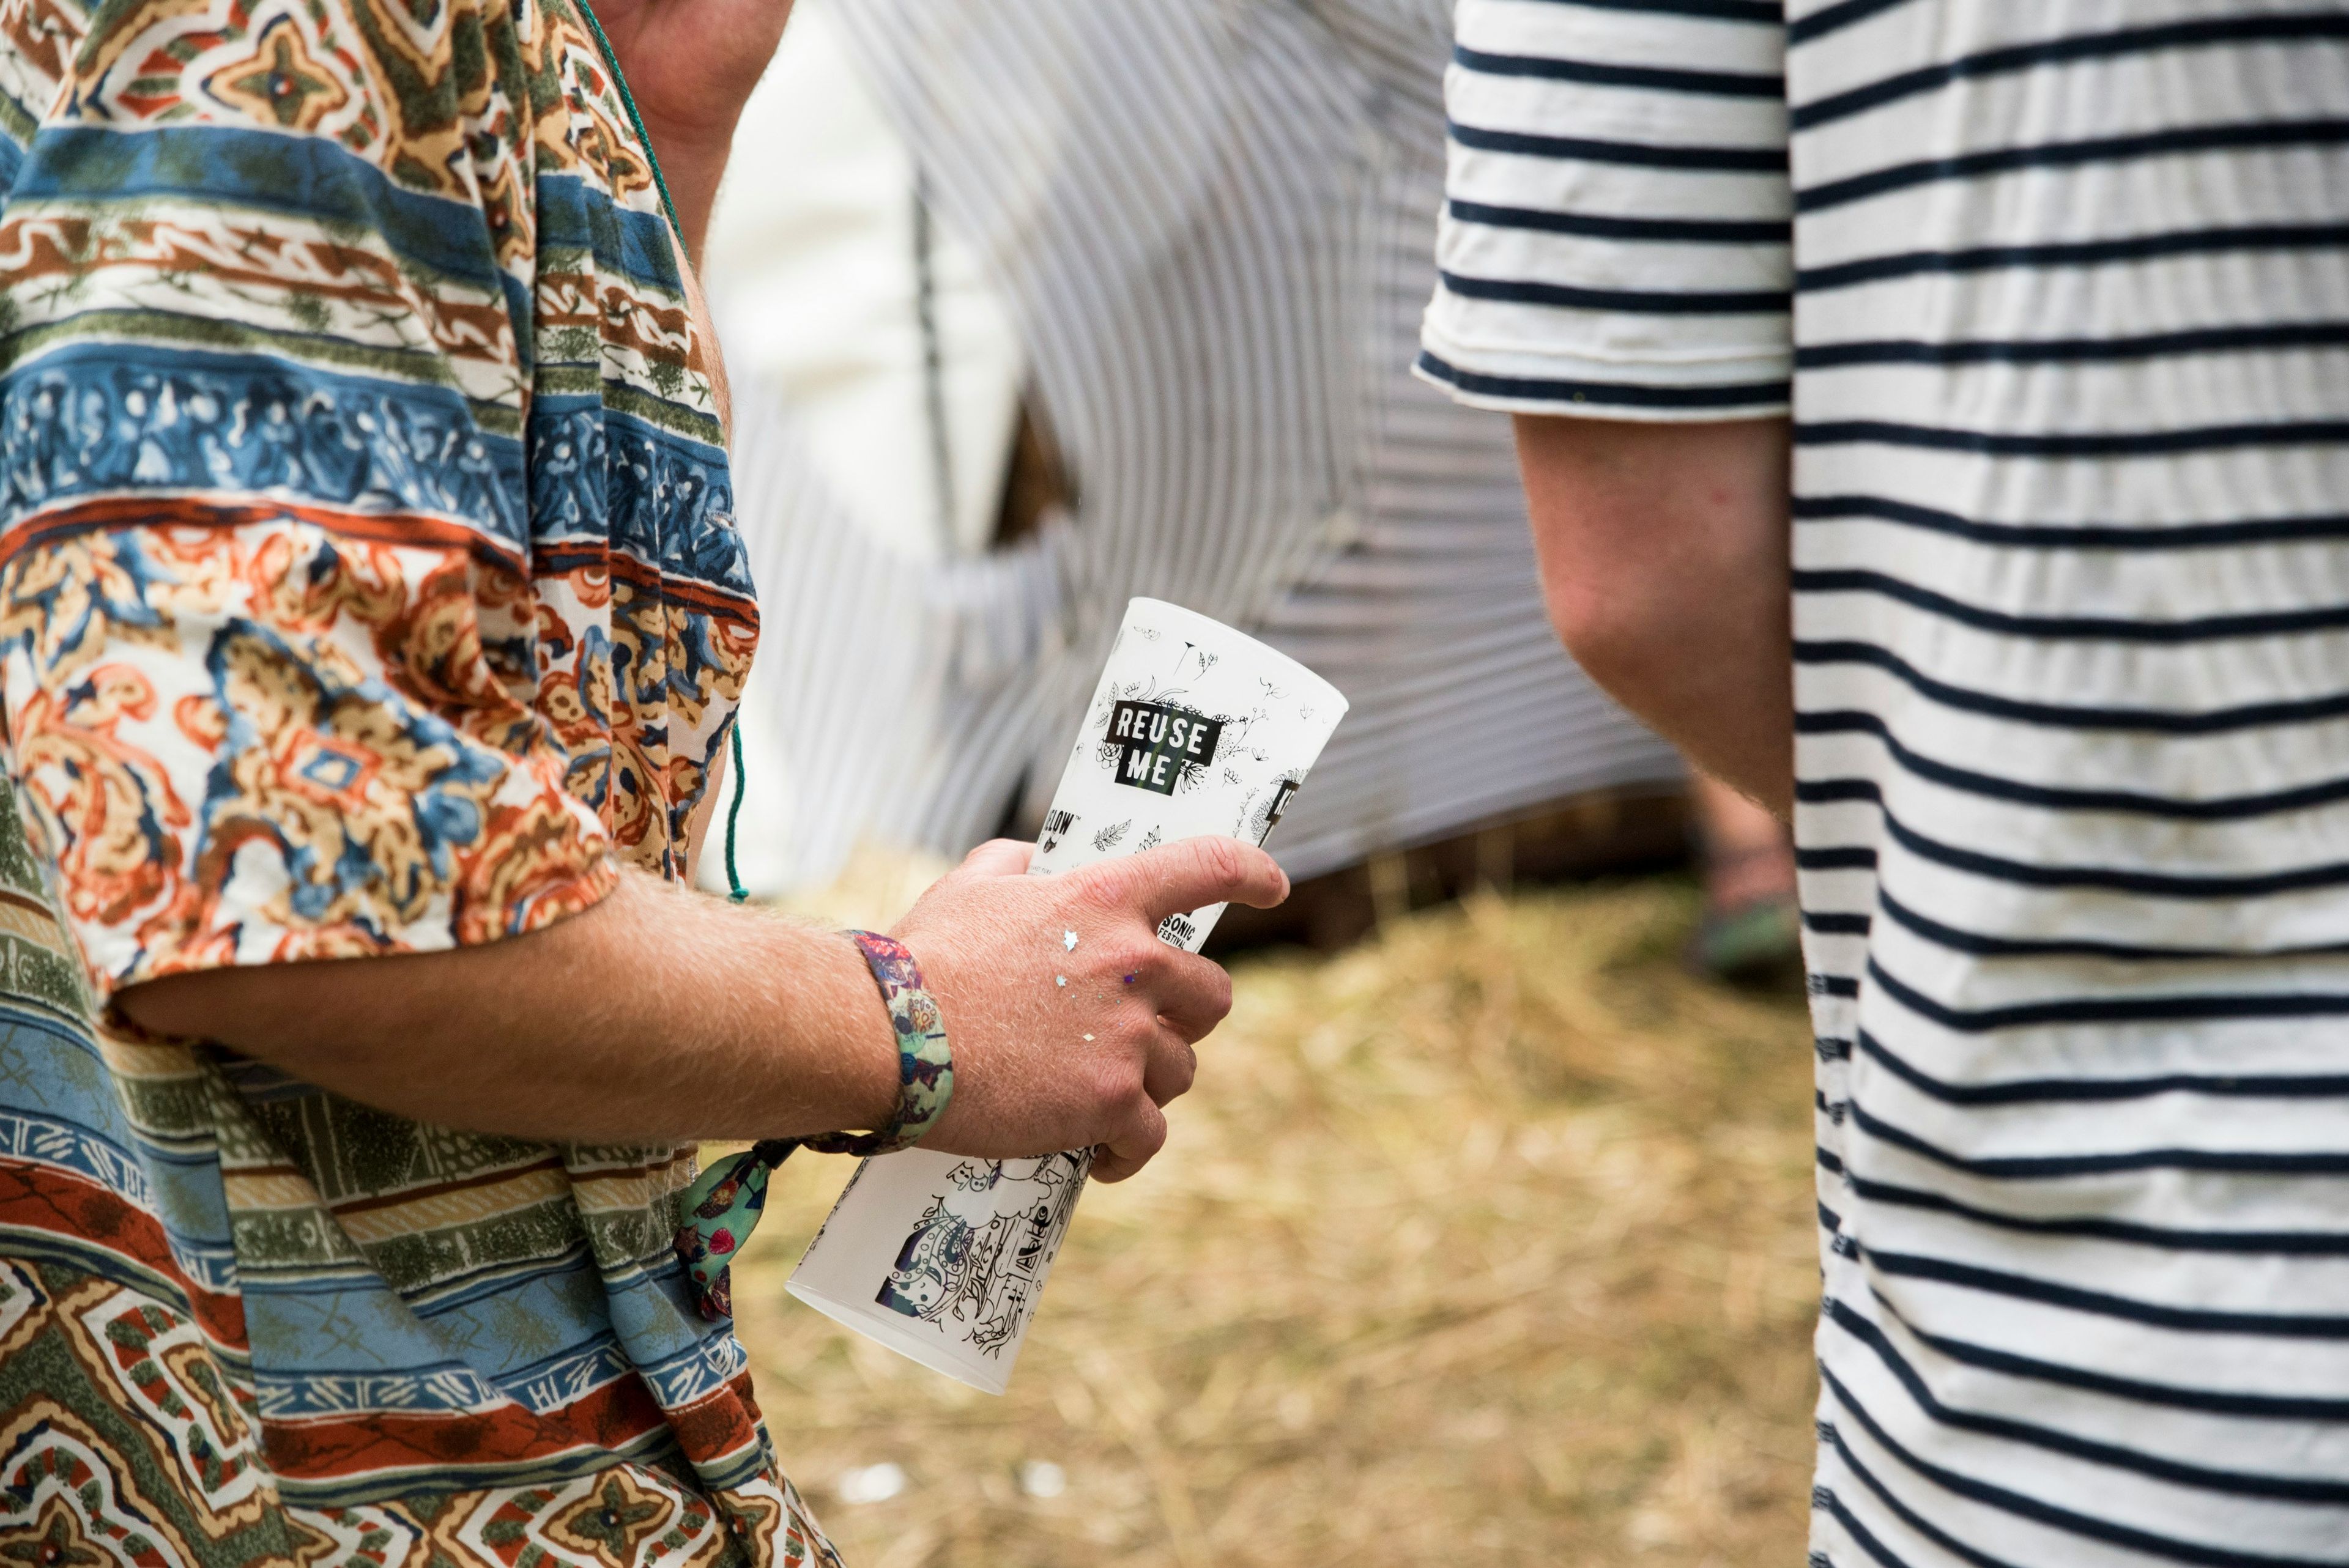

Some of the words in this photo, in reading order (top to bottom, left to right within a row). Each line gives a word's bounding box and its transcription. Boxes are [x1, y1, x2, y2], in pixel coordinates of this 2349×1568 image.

[1116, 708, 1208, 755] REUSE
[1126, 749, 1171, 786] ME
[1045, 809, 1075, 835] ELOW
[1157, 927, 1186, 950] FESTIVAL
[1162, 914, 1196, 941] SONIC
